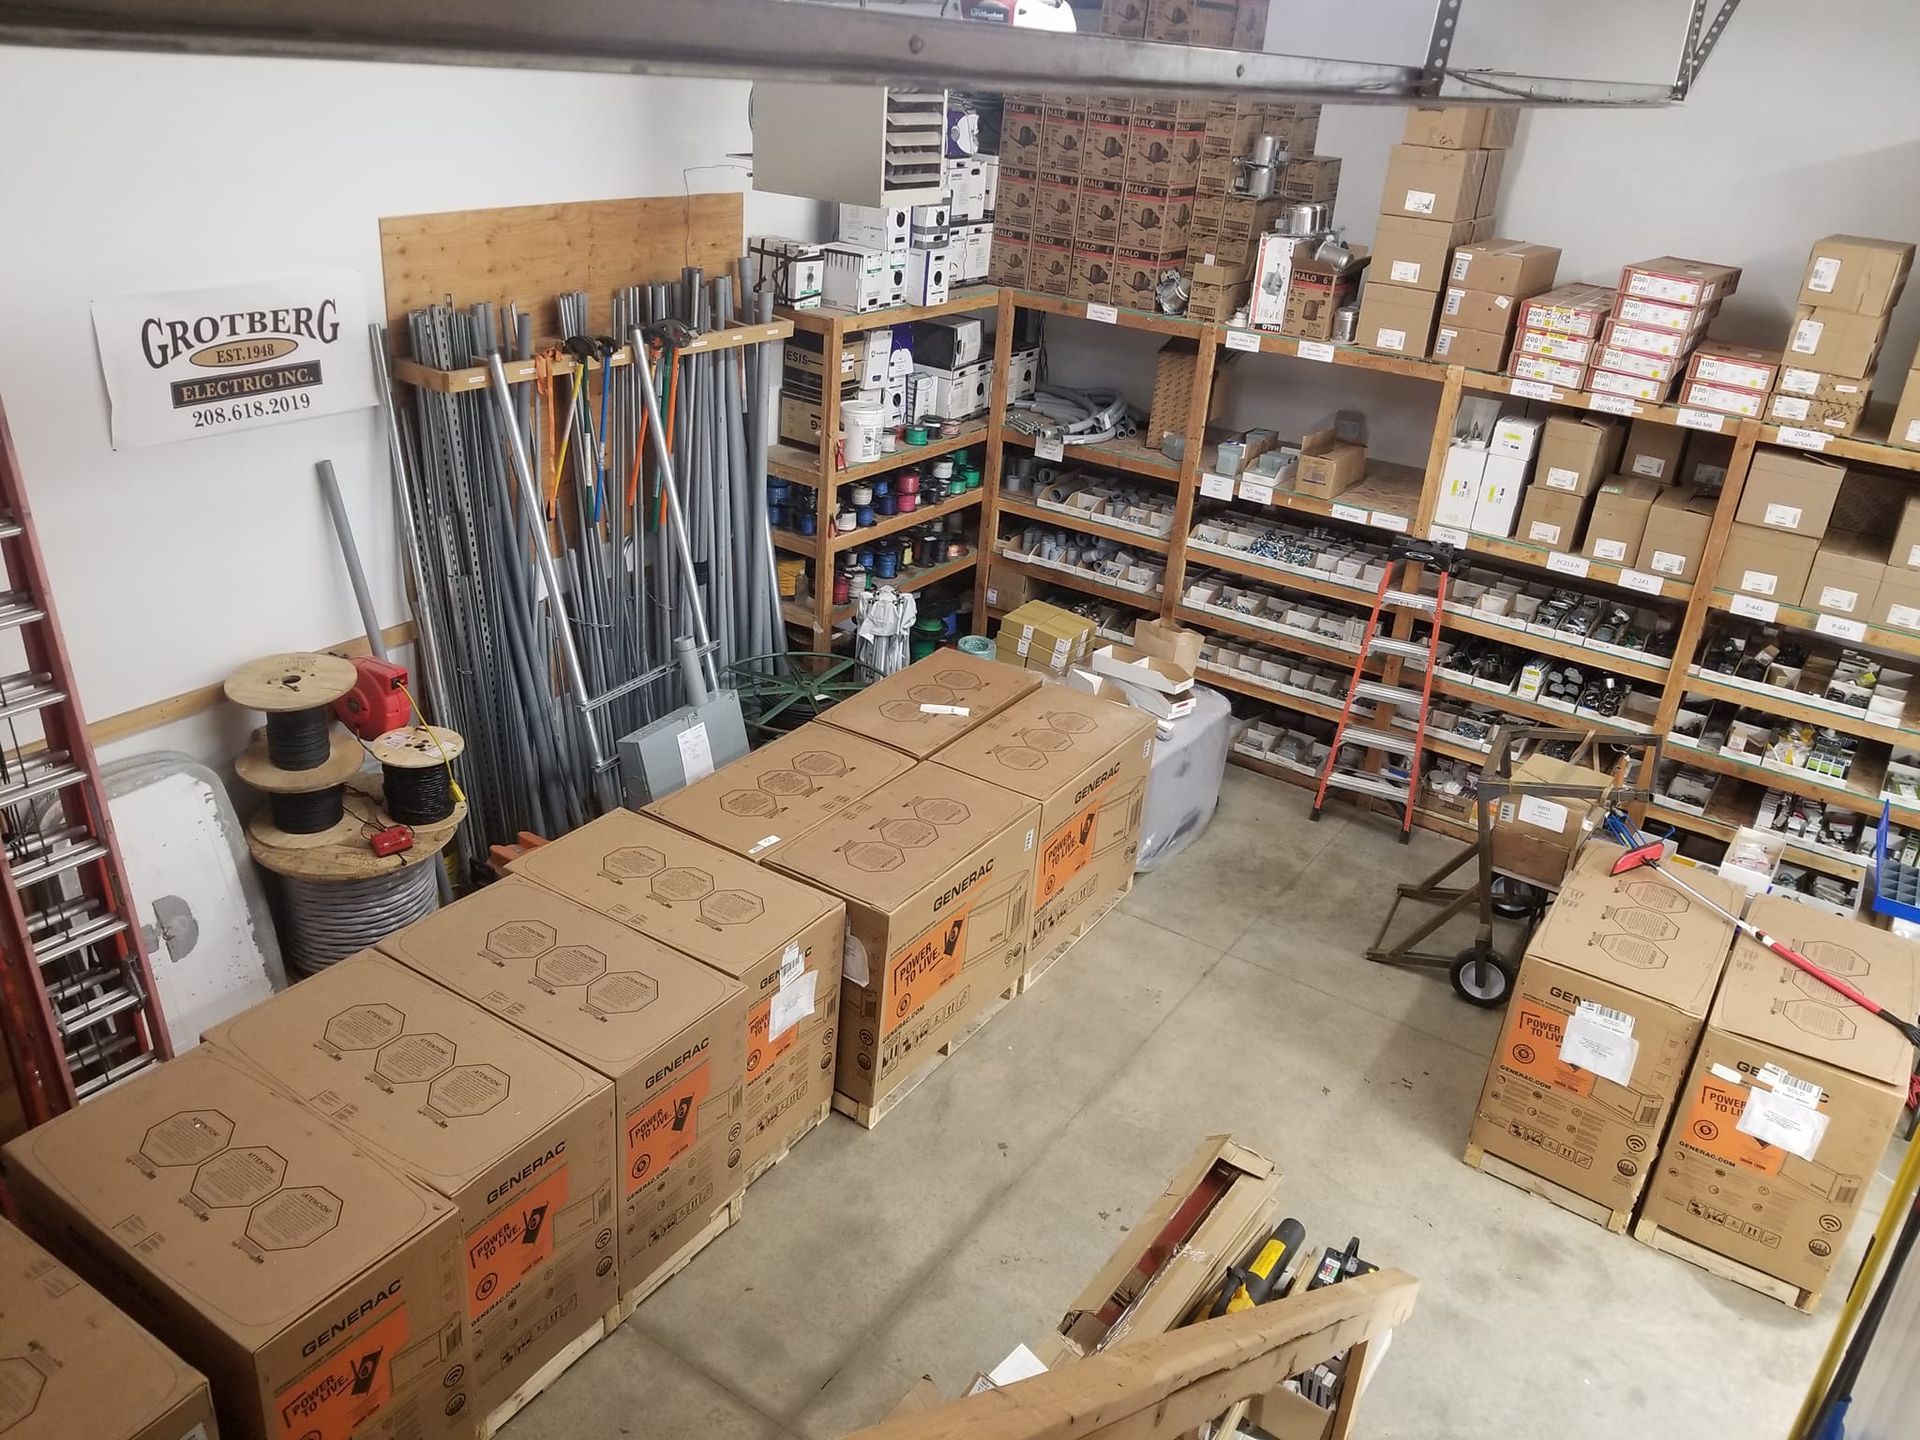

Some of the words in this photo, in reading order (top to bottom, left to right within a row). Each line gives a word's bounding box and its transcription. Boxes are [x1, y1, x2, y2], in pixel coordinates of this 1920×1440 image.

[1047, 108, 1067, 119] HALO
[1089, 113, 1111, 123] HALO
[1134, 118, 1156, 128] HALO
[1041, 172, 1061, 183] HALO
[1084, 178, 1104, 188] HALO
[1127, 184, 1149, 194] HALO
[1035, 234, 1054, 245] HALO
[1076, 241, 1096, 251] HALO
[1118, 248, 1139, 258] HALO
[1294, 272, 1317, 283] HALO
[1633, 275, 1646, 283] 200
[1625, 301, 1638, 309] 200
[1529, 310, 1542, 318] 200
[141, 298, 340, 369] GROTBERG
[1615, 327, 1628, 335] 200
[1605, 350, 1618, 358] 200
[1518, 360, 1531, 368] 200
[1701, 360, 1715, 368] 100
[182, 373, 275, 402] ELECTRIC
[278, 368, 314, 386] INC.
[1694, 385, 1707, 394] 100
[1600, 395, 1611, 403] 200
[192, 392, 311, 428] 208.618.2019
[1074, 762, 1120, 804] GENERAC
[1048, 831, 1072, 858] POWER
[1051, 854, 1060, 869] TO
[933, 858, 994, 912] GENERAC
[760, 946, 812, 990] GENC
[900, 942, 932, 981] POWER
[904, 972, 916, 987] TO
[1526, 1017, 1561, 1034] POWER
[1531, 1027, 1544, 1037] TO
[645, 1037, 710, 1089] GENERAC
[1499, 1064, 1552, 1090] GENERAC.COM
[1715, 1102, 1727, 1113] TO
[635, 1108, 664, 1138] POWER
[640, 1130, 651, 1142] TO
[1679, 1140, 1736, 1167] GENERAC.COM
[487, 1141, 566, 1204] GENERAC
[476, 1222, 511, 1258] POWER
[482, 1246, 496, 1260] TO
[471, 1282, 521, 1327] GENERAC.COM
[301, 1279, 403, 1358] GENERAC
[292, 1375, 335, 1416] POWER
[302, 1402, 317, 1417] TO
